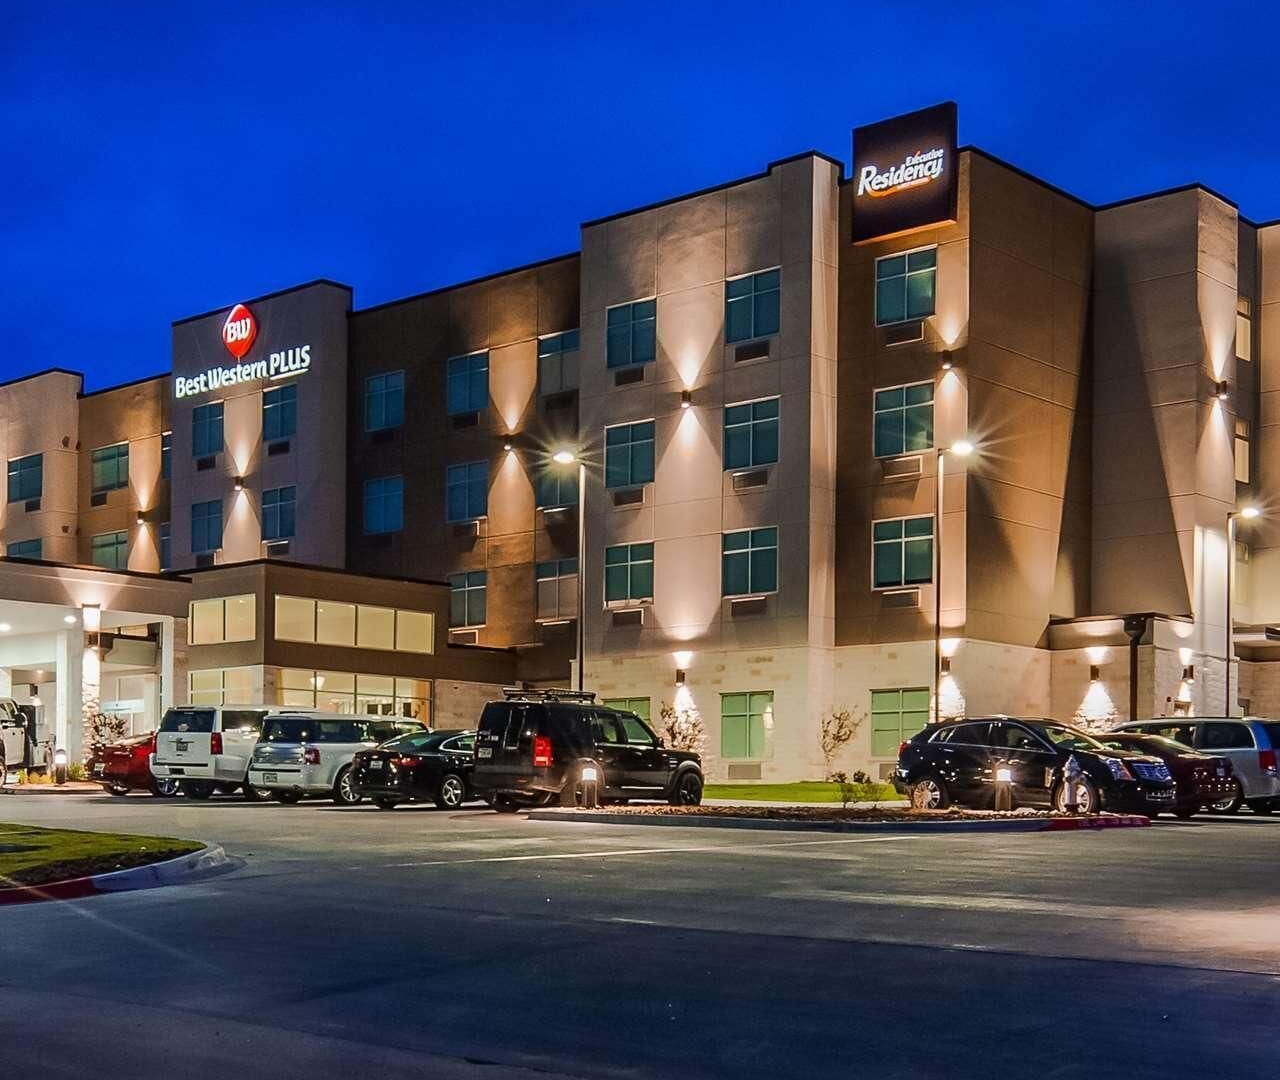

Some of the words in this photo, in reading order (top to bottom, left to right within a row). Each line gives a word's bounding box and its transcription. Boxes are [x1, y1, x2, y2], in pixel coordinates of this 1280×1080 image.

[857, 158, 943, 196] Residency
[225, 317, 251, 344] BW
[175, 373, 208, 399] Best
[207, 360, 270, 390] Western
[269, 345, 311, 376] PLUS
